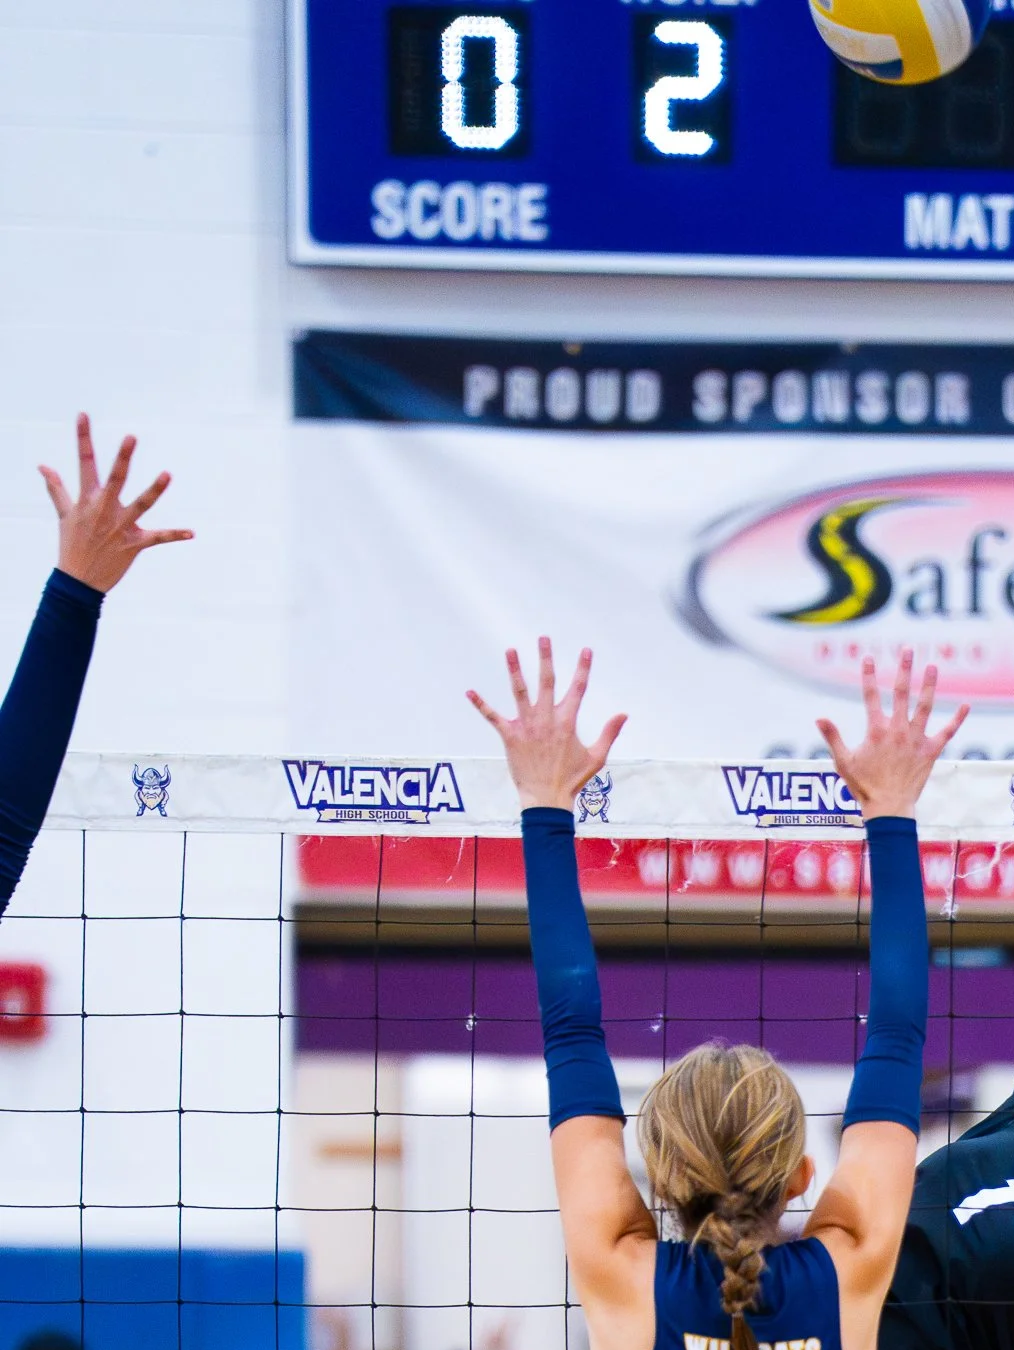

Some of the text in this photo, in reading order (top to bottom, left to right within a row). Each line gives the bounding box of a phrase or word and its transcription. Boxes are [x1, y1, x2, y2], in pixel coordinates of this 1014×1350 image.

[440, 15, 519, 149] 0
[643, 20, 723, 155] 2
[370, 181, 550, 242] SCORE
[462, 365, 662, 424] PROUD
[692, 369, 971, 426] SPONSOR
[282, 759, 466, 812] VALENCIA
[721, 766, 863, 814] VALENC
[335, 810, 412, 820] HIGH SCHOOL
[773, 815, 848, 824] HIGH SCHOOL
